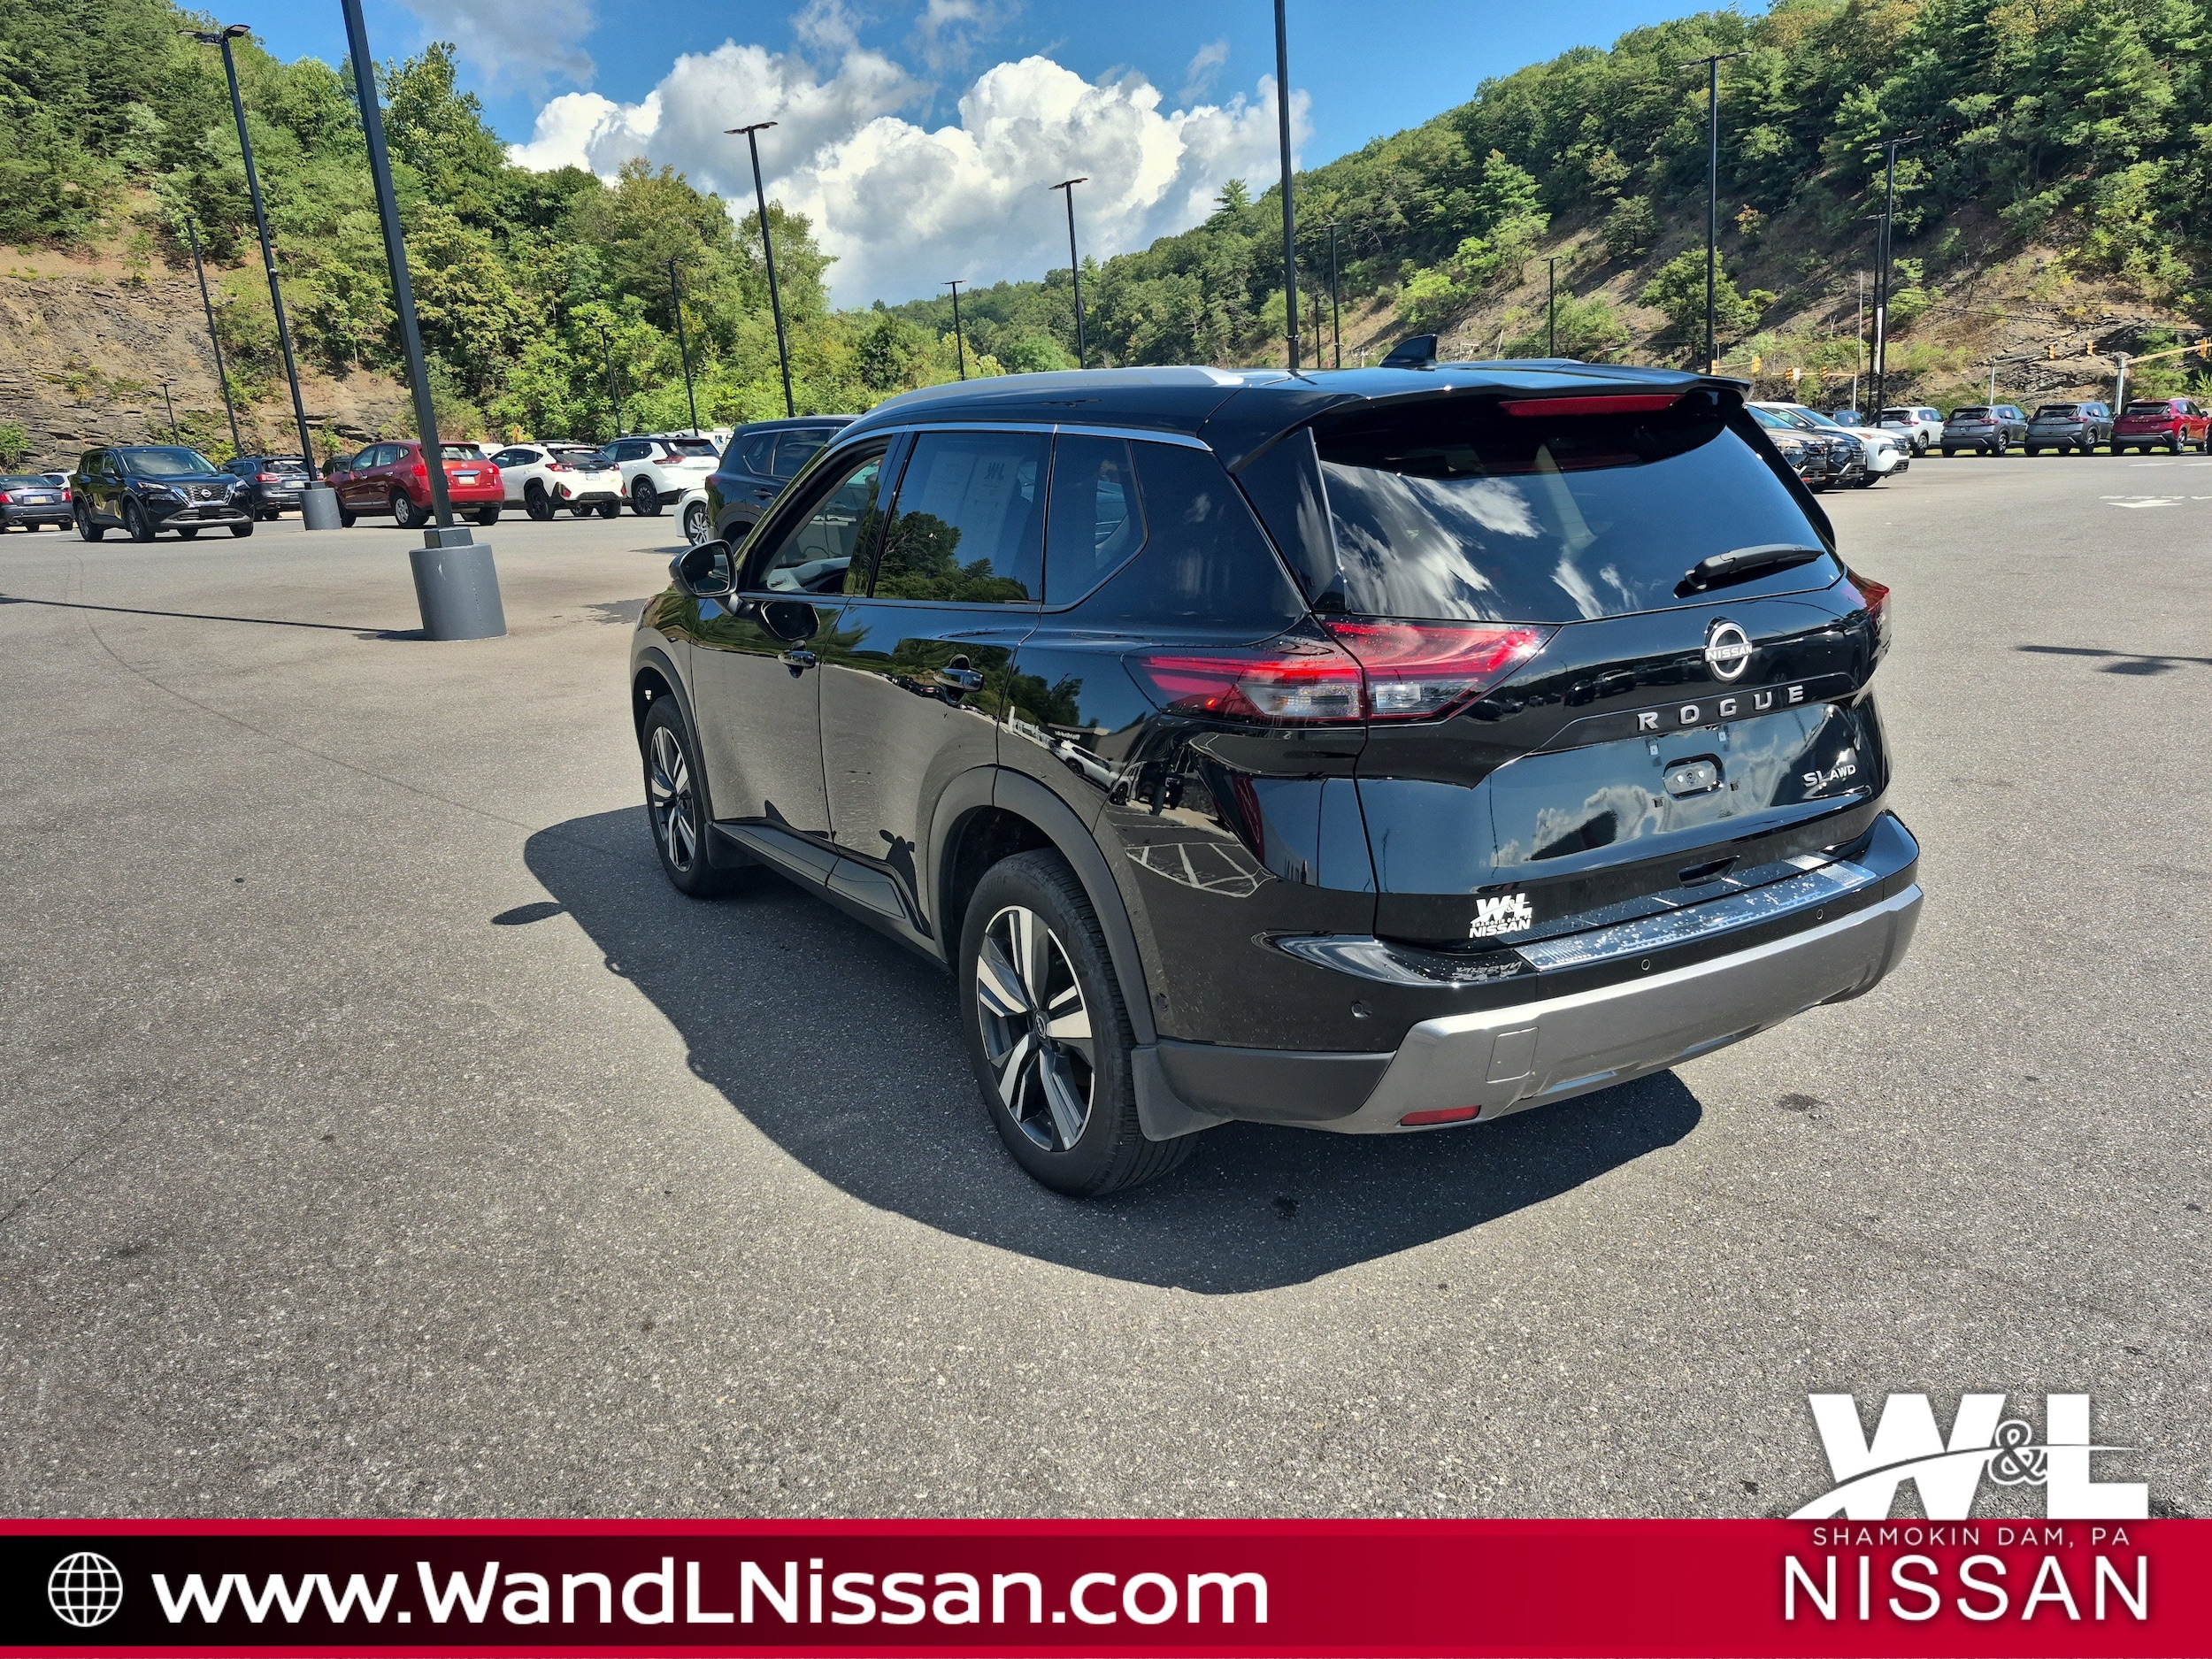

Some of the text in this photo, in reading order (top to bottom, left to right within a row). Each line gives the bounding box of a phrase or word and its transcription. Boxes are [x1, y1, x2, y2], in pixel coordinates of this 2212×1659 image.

[1706, 643, 1753, 662] NISSAN
[1638, 685, 1804, 731] ROGUE
[1830, 764, 1856, 780] AWD
[1471, 893, 1532, 924] W&L
[1470, 919, 1531, 938] NISSAN
